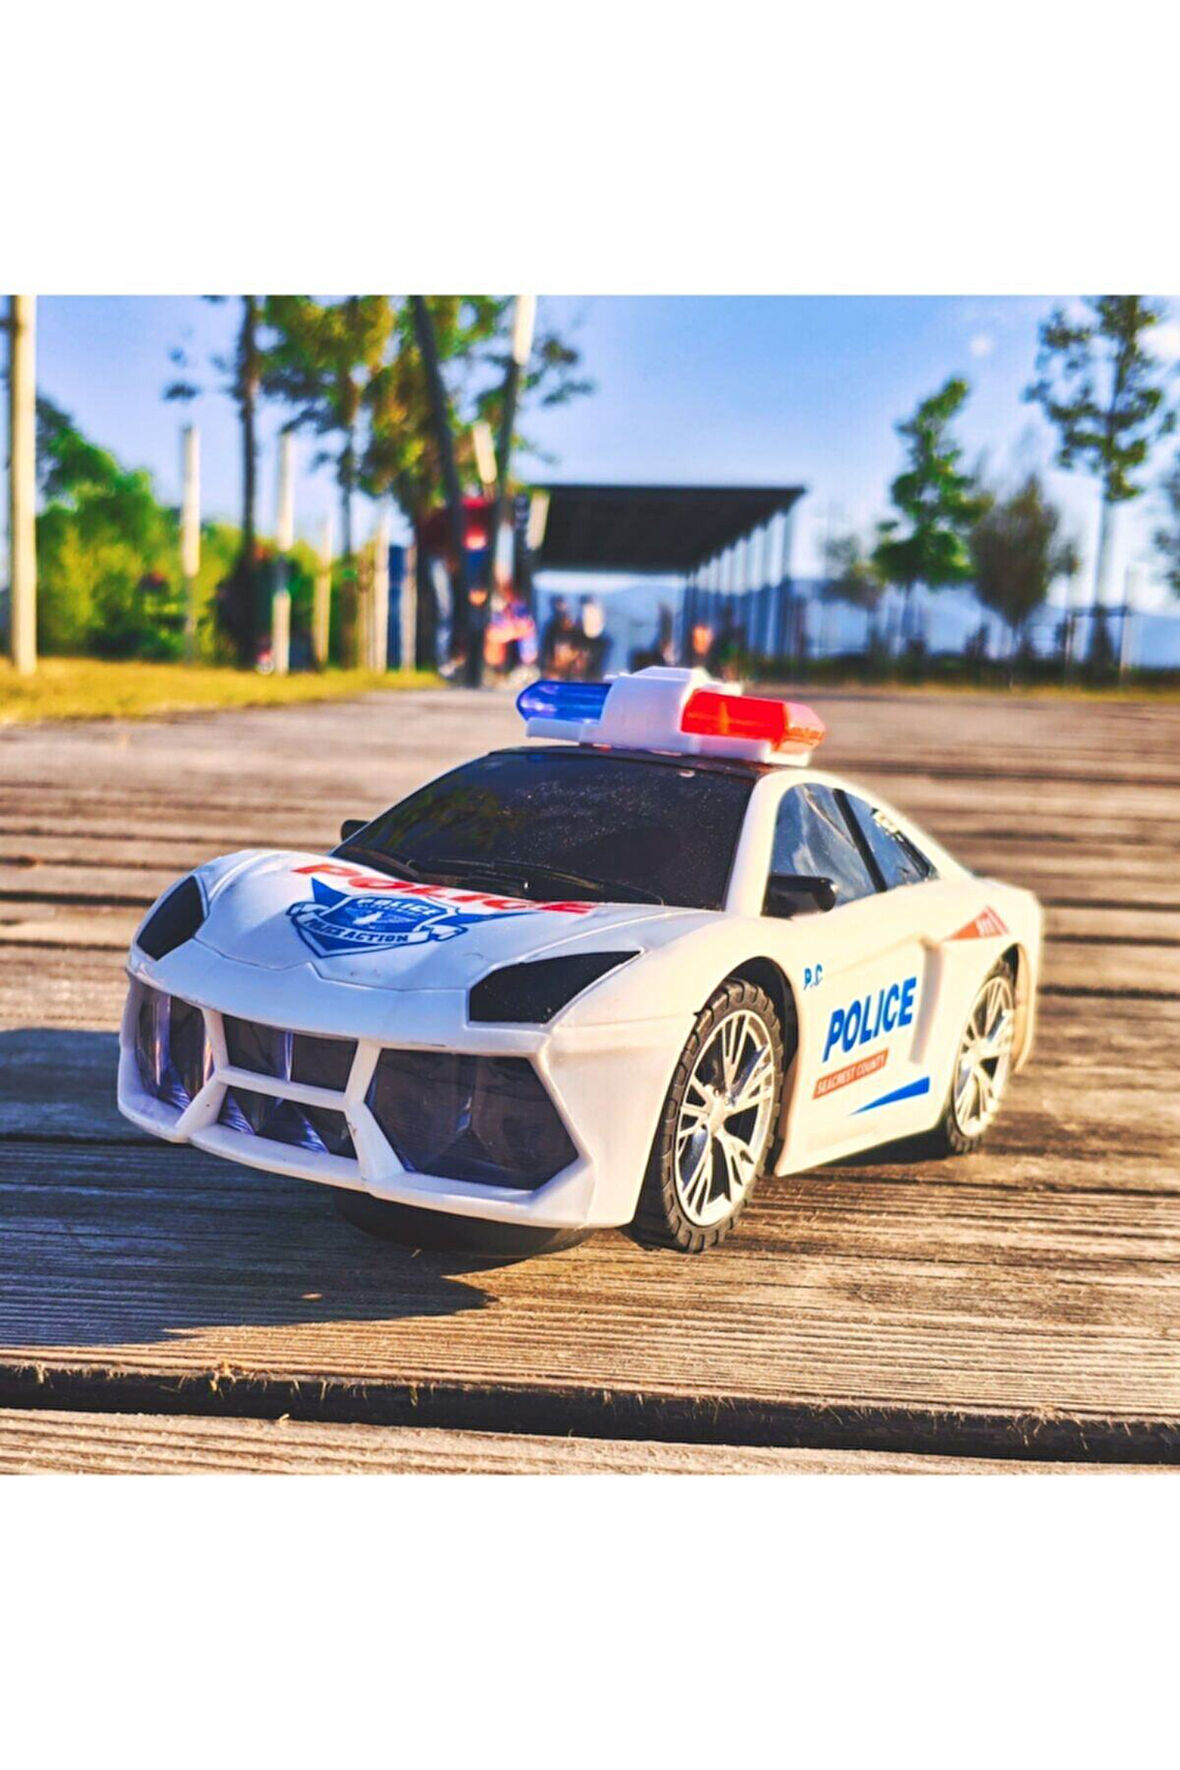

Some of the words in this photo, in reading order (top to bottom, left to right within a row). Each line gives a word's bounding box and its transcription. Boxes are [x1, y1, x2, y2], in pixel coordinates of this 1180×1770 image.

[291, 863, 598, 915] POLICE
[344, 931, 410, 943] ACTION
[822, 976, 918, 1063] POLICE
